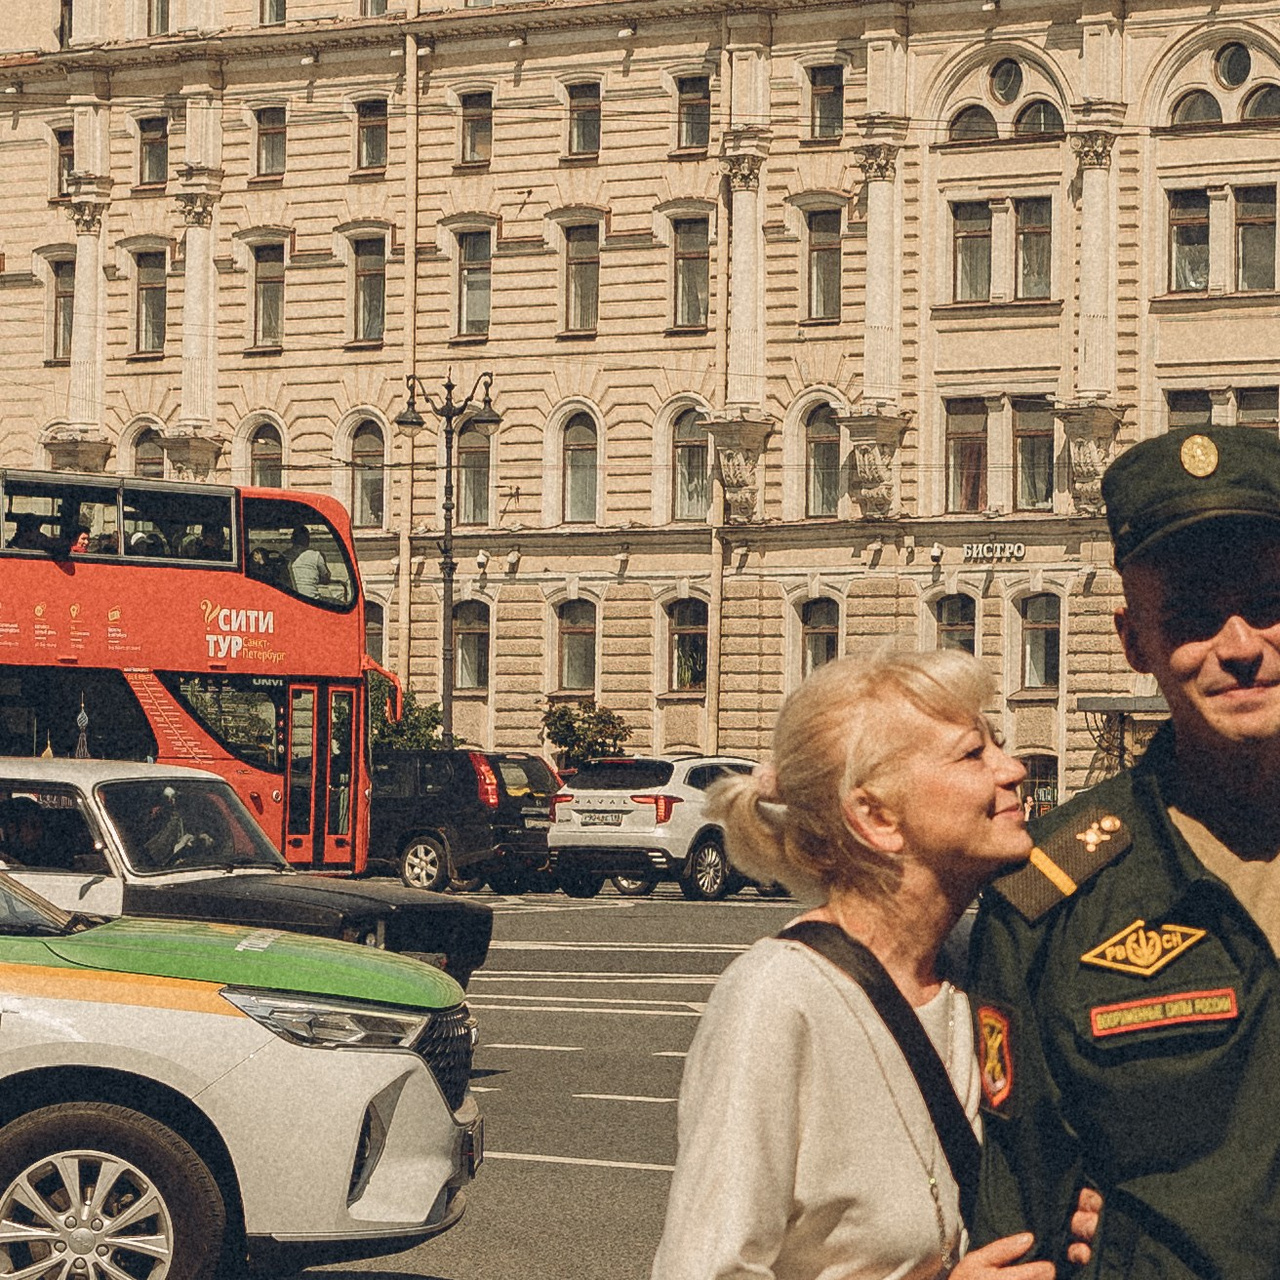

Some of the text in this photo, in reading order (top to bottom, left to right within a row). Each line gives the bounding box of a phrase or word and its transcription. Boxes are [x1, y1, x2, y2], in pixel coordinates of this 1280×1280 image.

[962, 542, 1026, 558] БИСТРО
[218, 608, 274, 634] СИТИ
[205, 634, 243, 658] ТУР
[243, 636, 270, 648] Санкт-
[242, 648, 286, 663] Петербург
